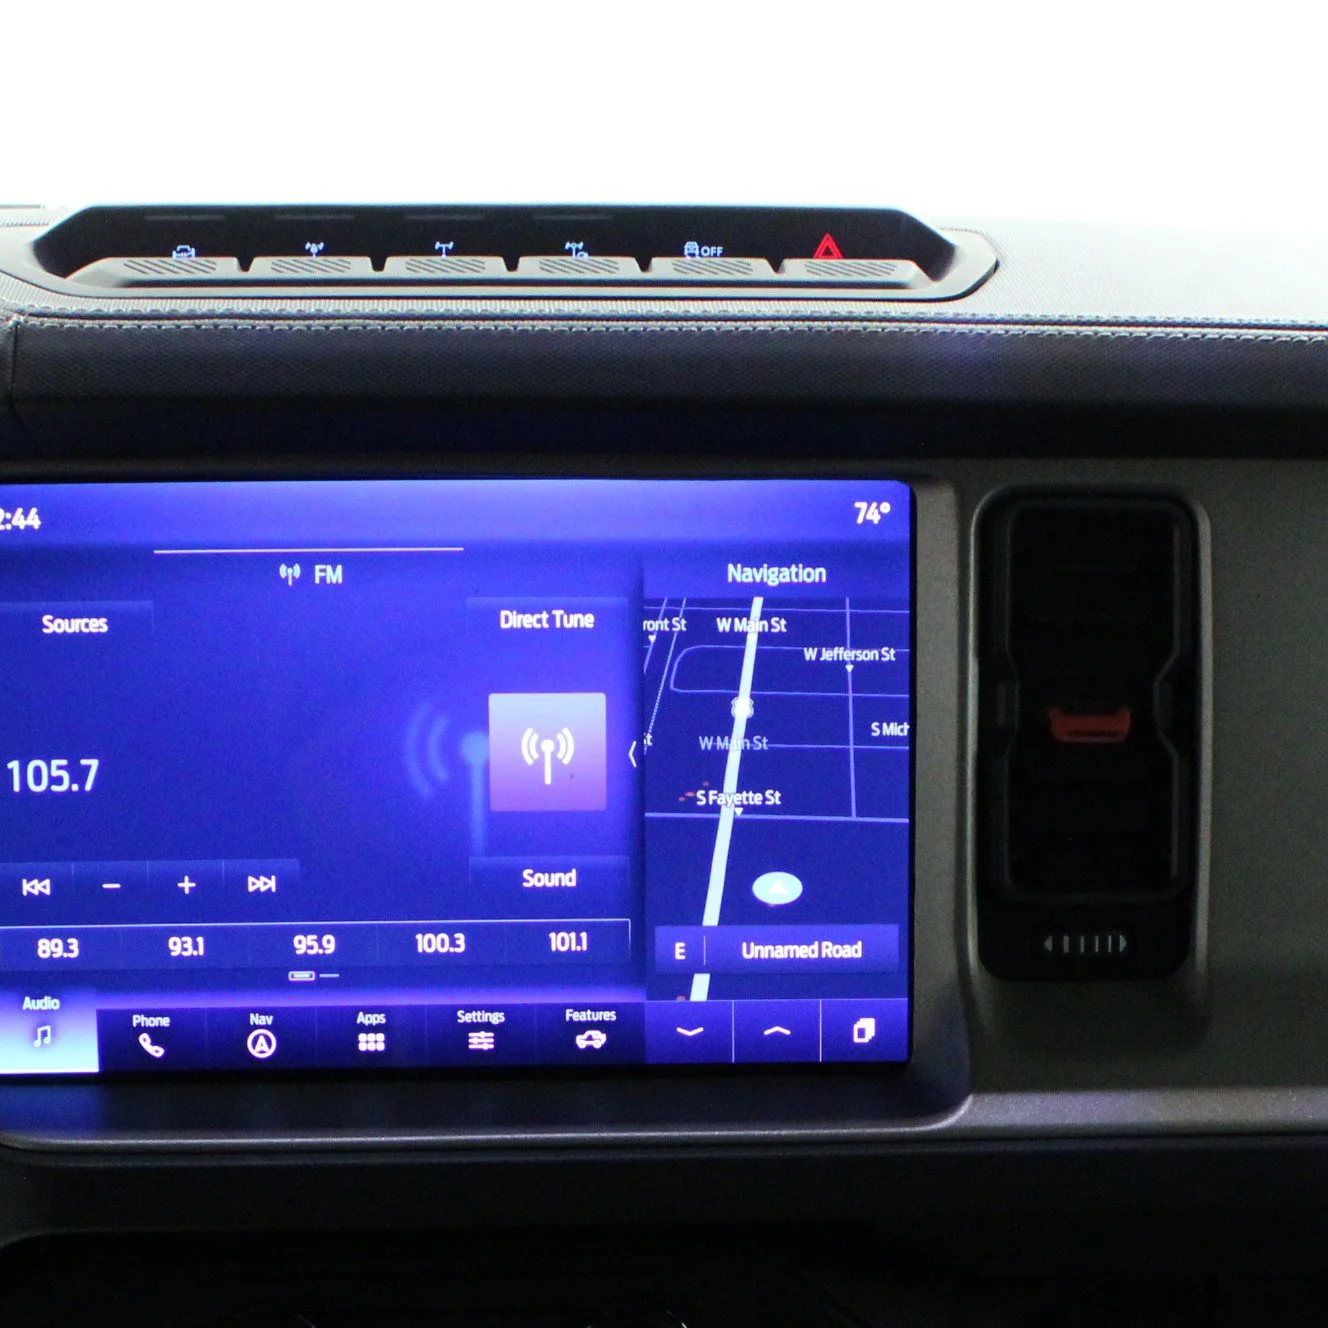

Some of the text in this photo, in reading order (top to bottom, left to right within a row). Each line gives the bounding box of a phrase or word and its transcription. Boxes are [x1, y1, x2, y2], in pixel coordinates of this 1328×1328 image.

[701, 246, 724, 258] OFF
[854, 501, 890, 525] 74°
[315, 564, 343, 585] FM
[727, 563, 827, 587] Navigation
[42, 614, 108, 635] Sources
[500, 609, 595, 629] Direct Tune
[672, 617, 687, 632] St
[716, 617, 787, 632] W Main St
[803, 646, 896, 662] W Jefferson St
[871, 721, 881, 737] S
[698, 735, 769, 751] W Main St
[7, 758, 100, 793] 105.7
[696, 790, 781, 808] S Fayette St
[522, 868, 577, 888] Sound
[37, 938, 80, 959] 89.3
[168, 936, 205, 957] 93.1
[293, 934, 336, 956] 95.9
[415, 933, 466, 955] 100.3
[549, 931, 588, 953] 101.1
[674, 942, 686, 961] E
[741, 940, 863, 961] Unnamed Road
[22, 995, 60, 1012] Audio
[132, 1013, 170, 1029] Phone
[250, 1012, 274, 1028] Nav
[356, 1010, 387, 1028] Apps
[457, 1008, 506, 1026] Settings
[565, 1007, 617, 1023] Features
